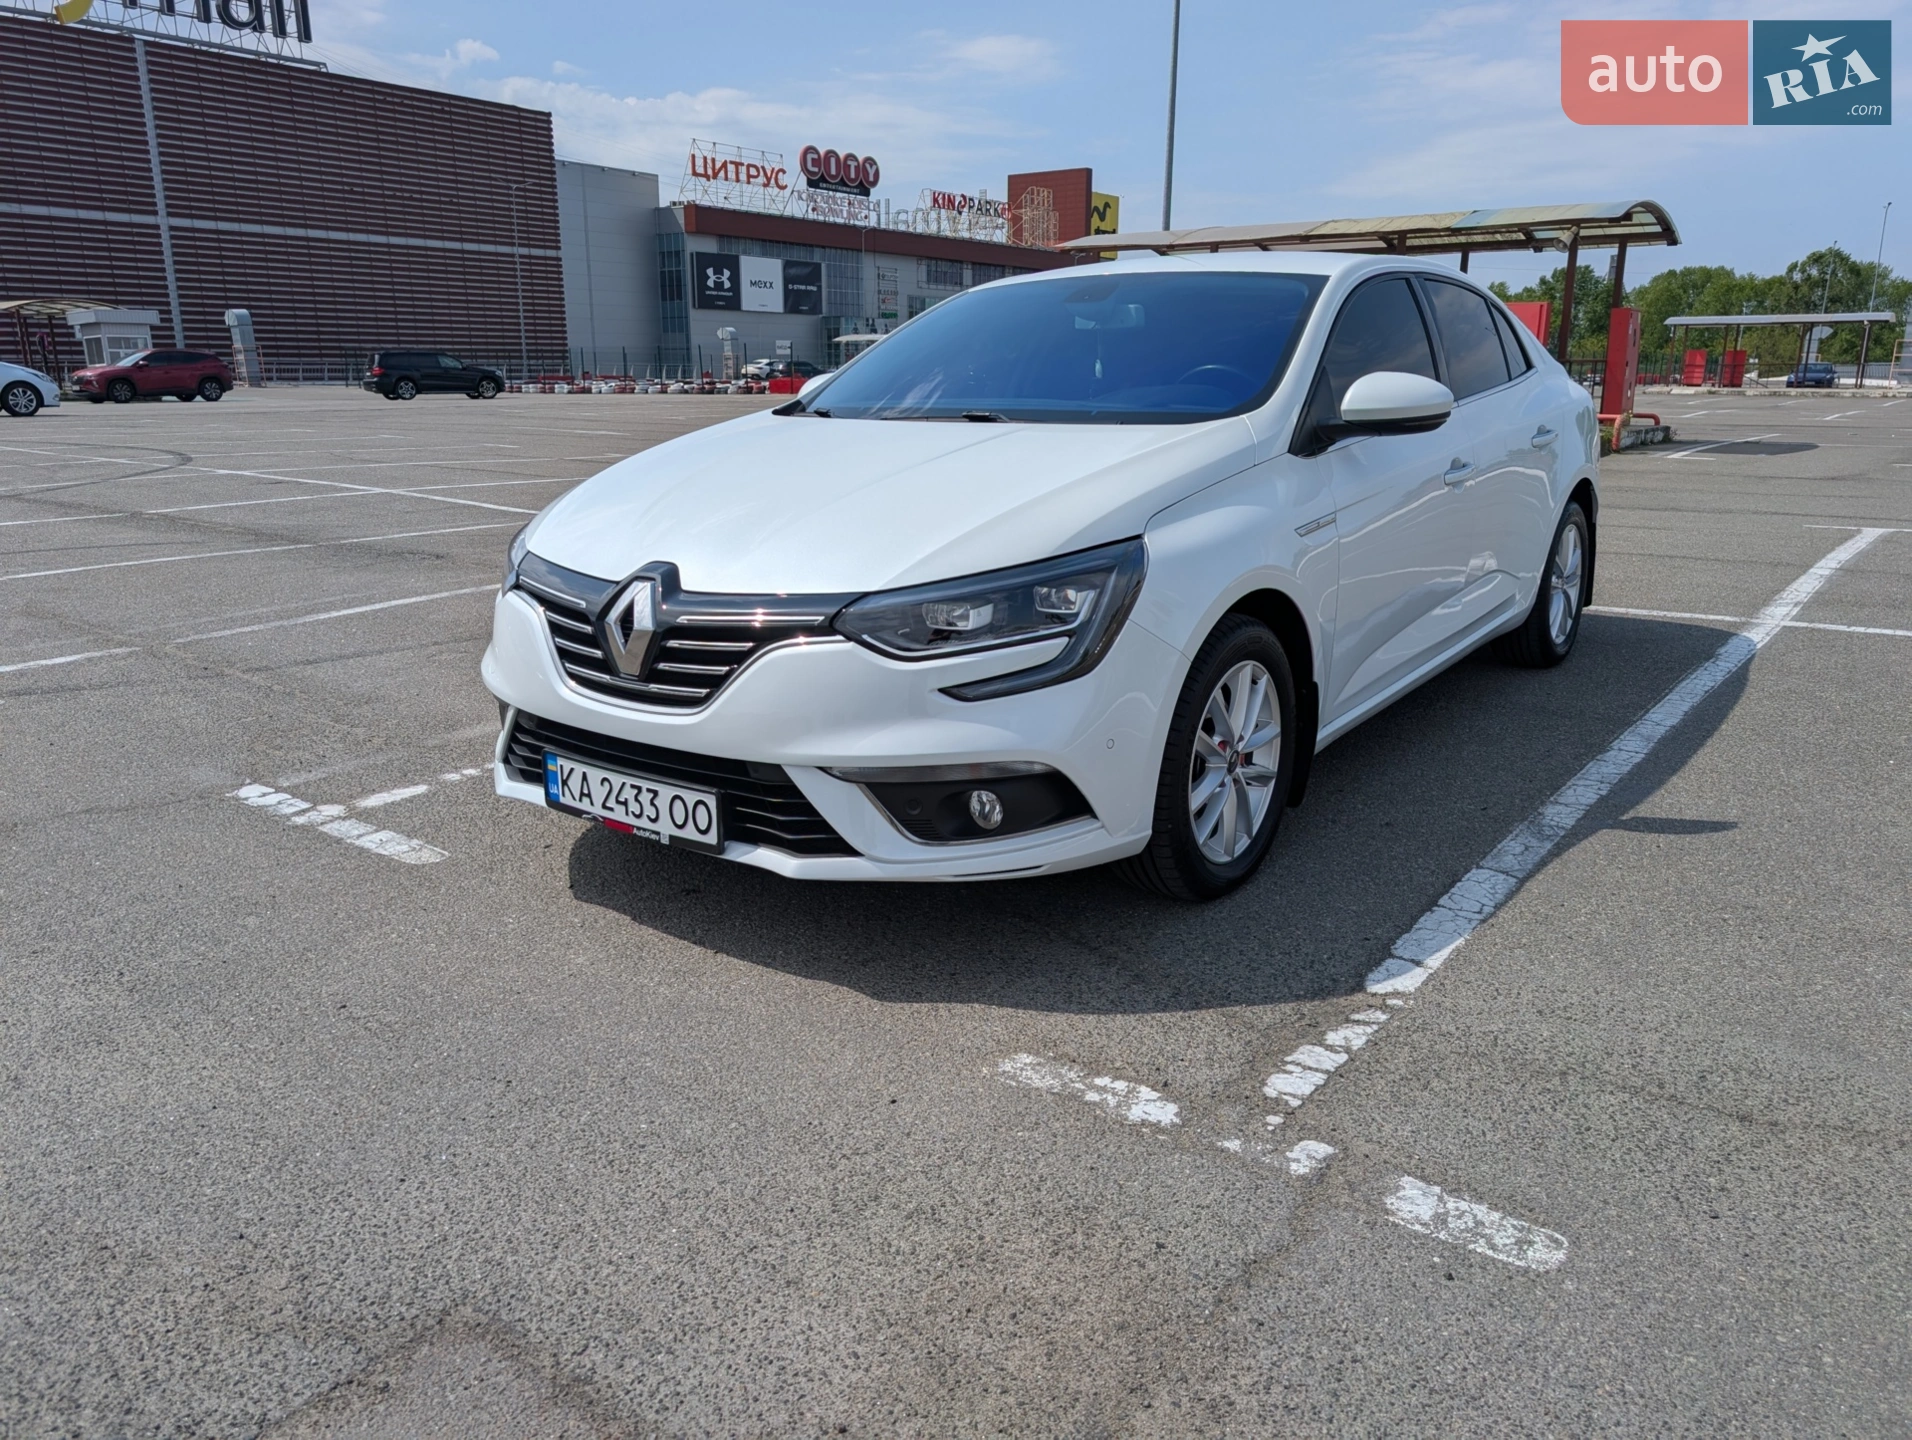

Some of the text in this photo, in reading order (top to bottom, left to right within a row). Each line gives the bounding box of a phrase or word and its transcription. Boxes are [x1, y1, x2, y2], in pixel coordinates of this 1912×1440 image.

[690, 153, 788, 190] ЦИТРУС
[805, 152, 878, 183] CITY
[819, 182, 860, 194] ENTERTAINMENT
[548, 782, 559, 795] UA
[559, 763, 595, 807] KA
[600, 776, 660, 824] 2433
